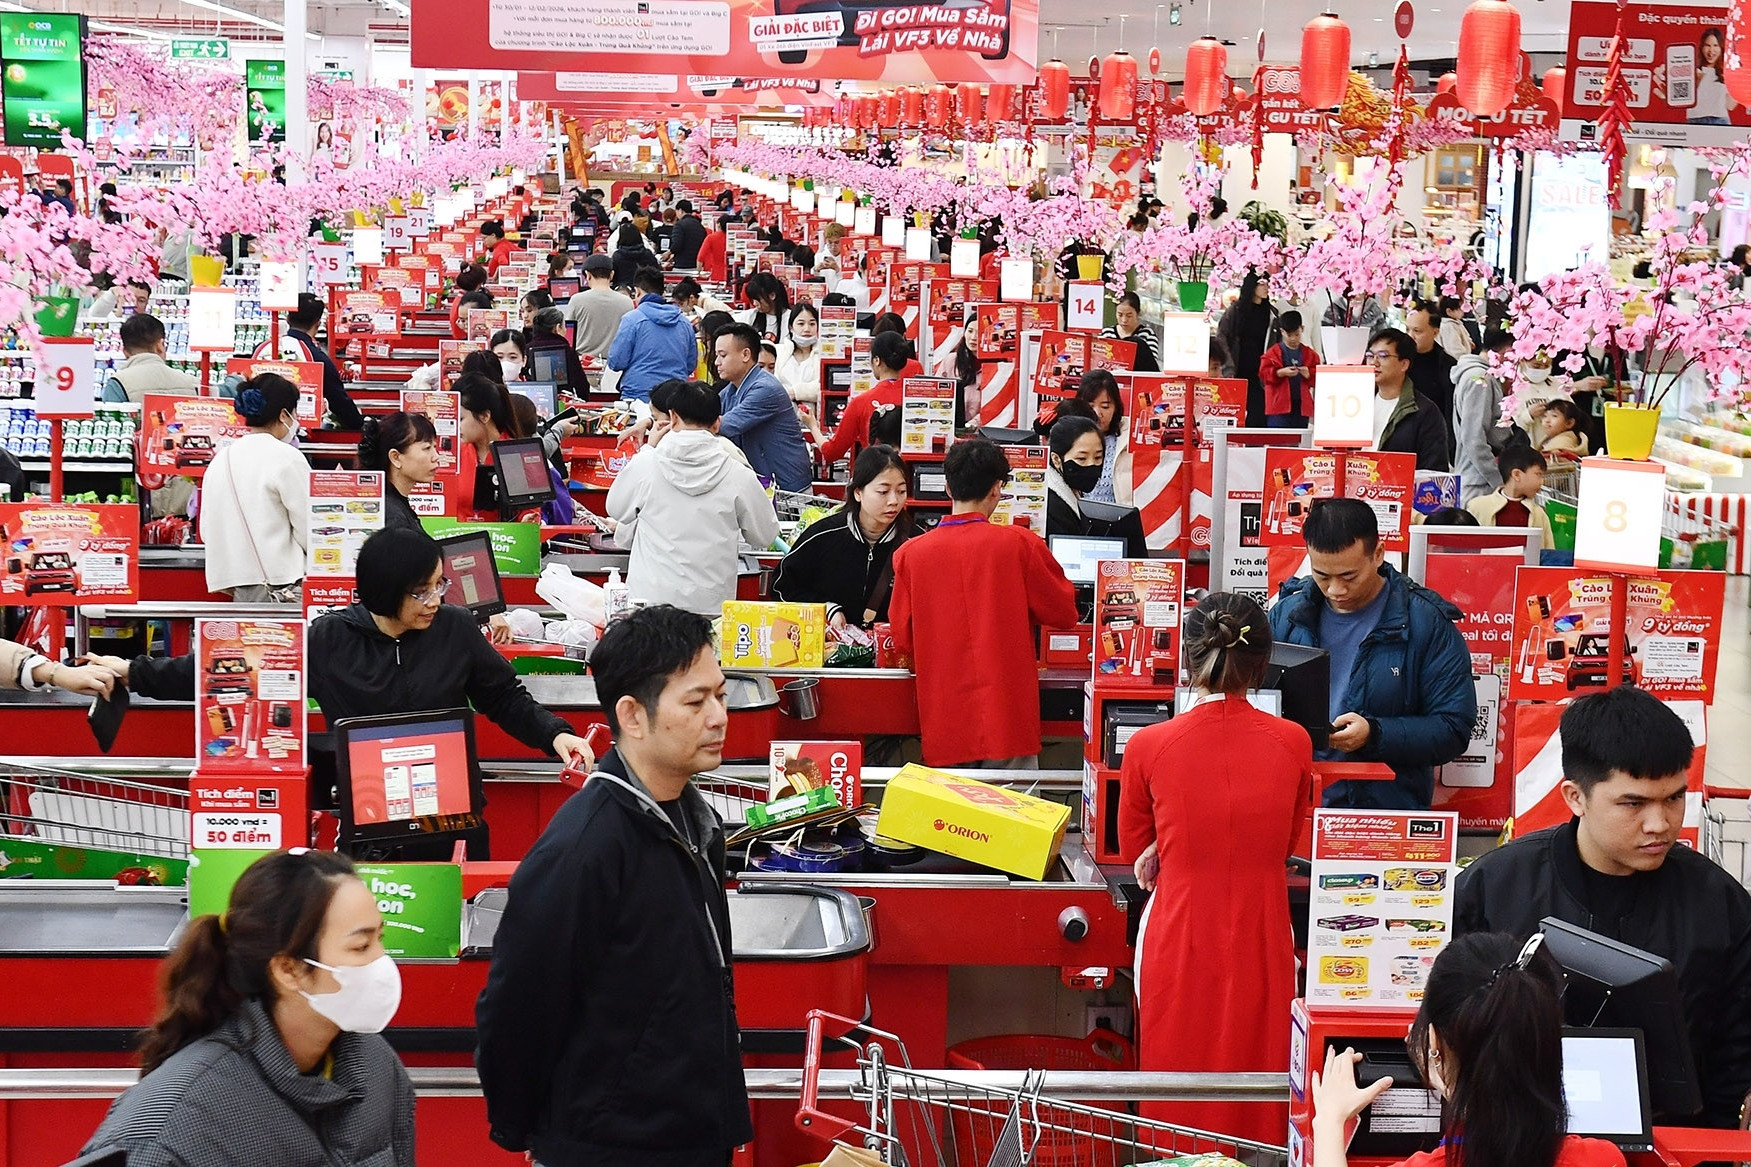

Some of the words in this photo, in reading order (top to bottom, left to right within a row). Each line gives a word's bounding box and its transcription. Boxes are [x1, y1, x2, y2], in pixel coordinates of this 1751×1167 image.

[857, 10, 876, 30] Đi
[878, 8, 918, 28] GO!
[919, 7, 960, 26] Mua
[964, 5, 1007, 30] Sắm
[1638, 14, 1662, 26] Đặc
[1664, 16, 1698, 27] quyền
[754, 18, 781, 37] GIẢI
[784, 18, 808, 38] ĐẶC
[814, 15, 841, 36] BIỆT
[14, 32, 32, 47] TẾT
[34, 37, 47, 49] TỰ
[50, 38, 67, 48] TIN
[860, 31, 888, 54] Lái
[892, 31, 932, 50] VF3
[933, 27, 960, 47] Về
[963, 31, 1003, 51] Nhà
[1268, 111, 1291, 124] GU
[1293, 109, 1320, 125] TẾT
[1510, 104, 1548, 125] TẾT
[1542, 184, 1600, 205] SALE
[411, 217, 423, 228] 21
[390, 227, 404, 238] 19
[321, 257, 338, 271] 15
[1075, 298, 1096, 315] 14
[1174, 335, 1198, 354] 12
[56, 366, 74, 391] 9
[1202, 405, 1210, 414] 9
[1327, 394, 1362, 418] 10
[1312, 460, 1329, 468] Cào
[1347, 461, 1368, 470] Xuân
[1309, 468, 1331, 477] Trúng
[1347, 469, 1371, 478] Khủng
[1356, 486, 1367, 498] 9
[1367, 488, 1378, 499] tỷ
[418, 502, 440, 512] điểm
[1603, 499, 1628, 533] 8
[1243, 516, 1261, 530] Th
[79, 539, 89, 551] 9
[1234, 558, 1252, 566] Tích
[1253, 557, 1268, 566] điể
[1101, 561, 1129, 577] GO!
[1230, 567, 1245, 577] Đổi
[1246, 568, 1263, 579] quà
[309, 588, 329, 597] Tích
[330, 586, 351, 598] điểm
[1581, 583, 1604, 593] Cào
[1629, 583, 1658, 595] Xuân
[1576, 594, 1606, 605] Trúng
[1630, 594, 1662, 606] Khủng
[1470, 609, 1491, 624] MÃ
[1493, 612, 1514, 626] QR
[203, 621, 239, 641] GO!
[1643, 617, 1656, 632] 9
[1657, 619, 1671, 635] tỷ
[1460, 629, 1478, 641] eal
[1481, 628, 1498, 641] tối
[734, 623, 753, 660] Tipo
[1651, 677, 1667, 685] GO!
[1654, 683, 1671, 691] VF3
[774, 747, 785, 758] 10
[196, 788, 222, 799] Tích
[223, 786, 255, 799] điểm
[846, 786, 854, 809] ORIO
[232, 799, 251, 808] sắm
[206, 817, 239, 827] 10.000
[1331, 815, 1357, 825] Mua
[1359, 815, 1398, 827] nhiều
[1457, 816, 1488, 828] huyến
[207, 831, 228, 844] 50
[232, 827, 271, 844] điểm
[947, 823, 990, 844] ORION
